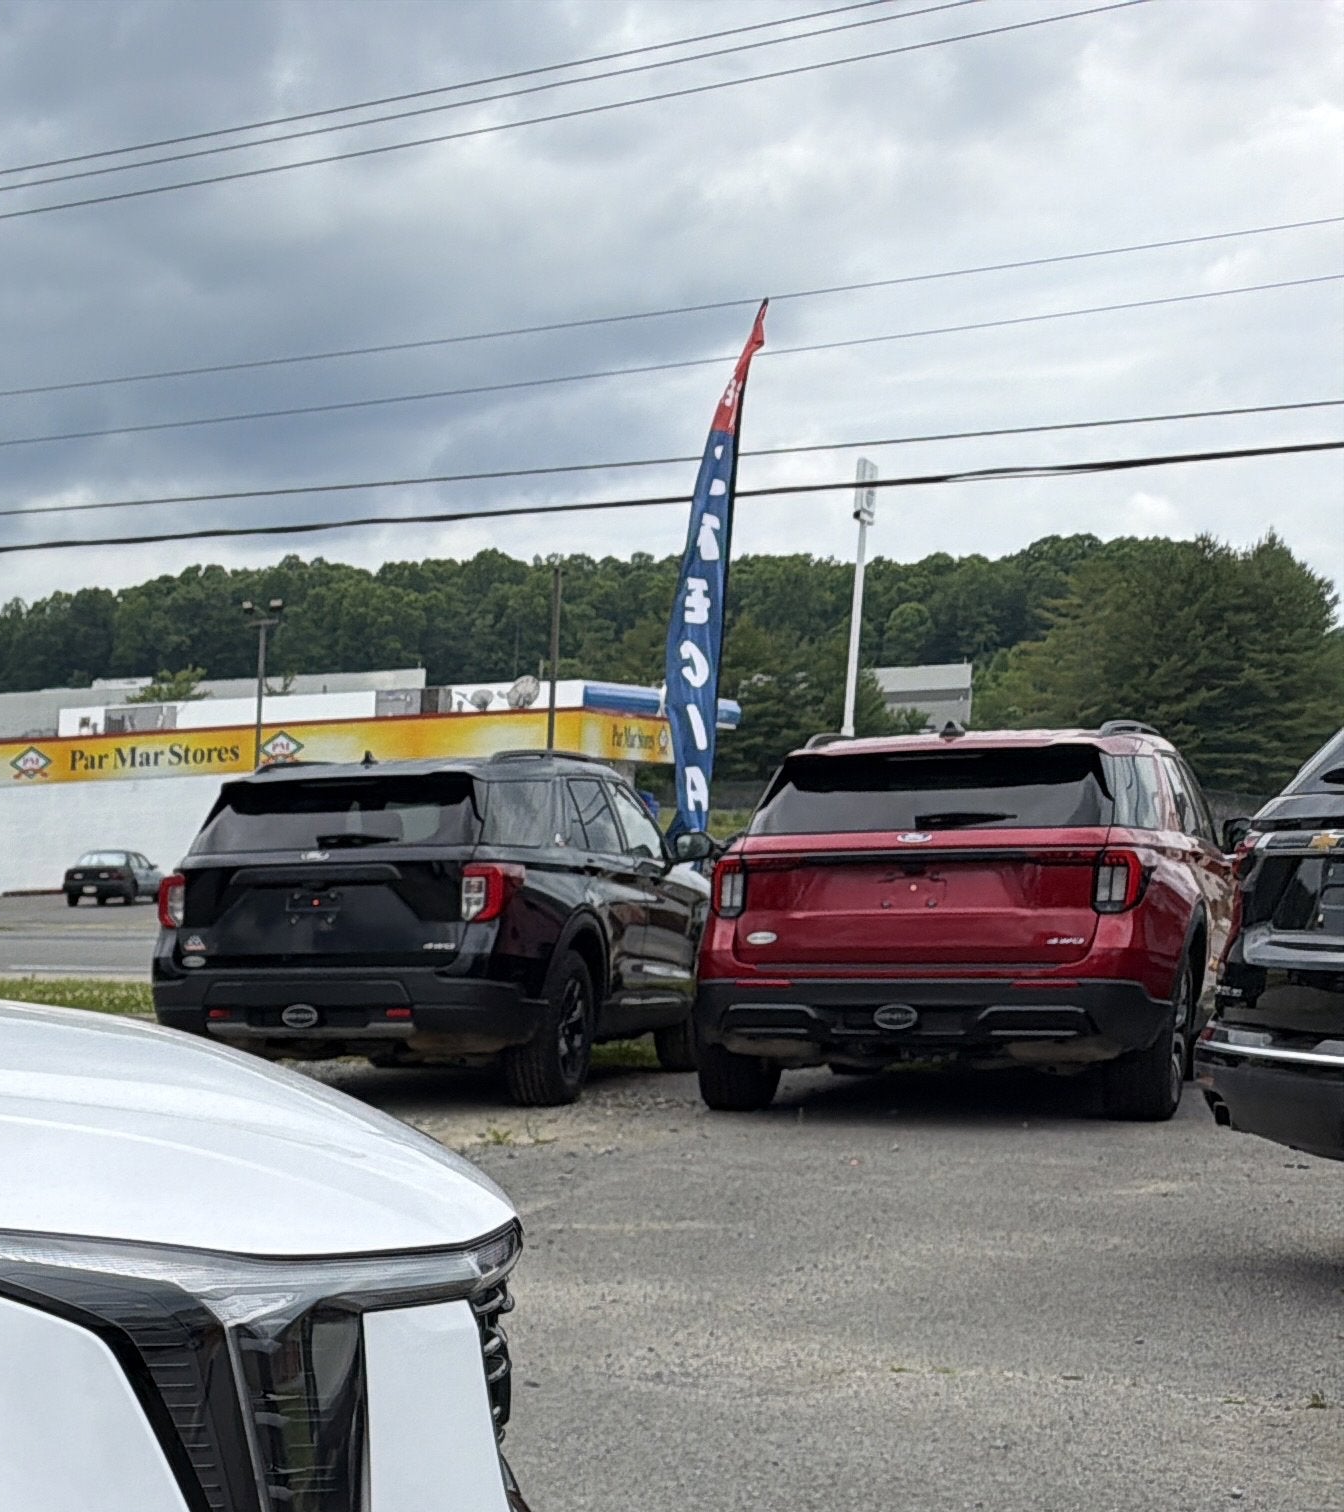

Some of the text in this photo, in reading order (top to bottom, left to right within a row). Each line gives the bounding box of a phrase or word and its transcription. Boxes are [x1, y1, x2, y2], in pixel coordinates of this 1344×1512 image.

[70, 743, 240, 771] Par Mar Stores
